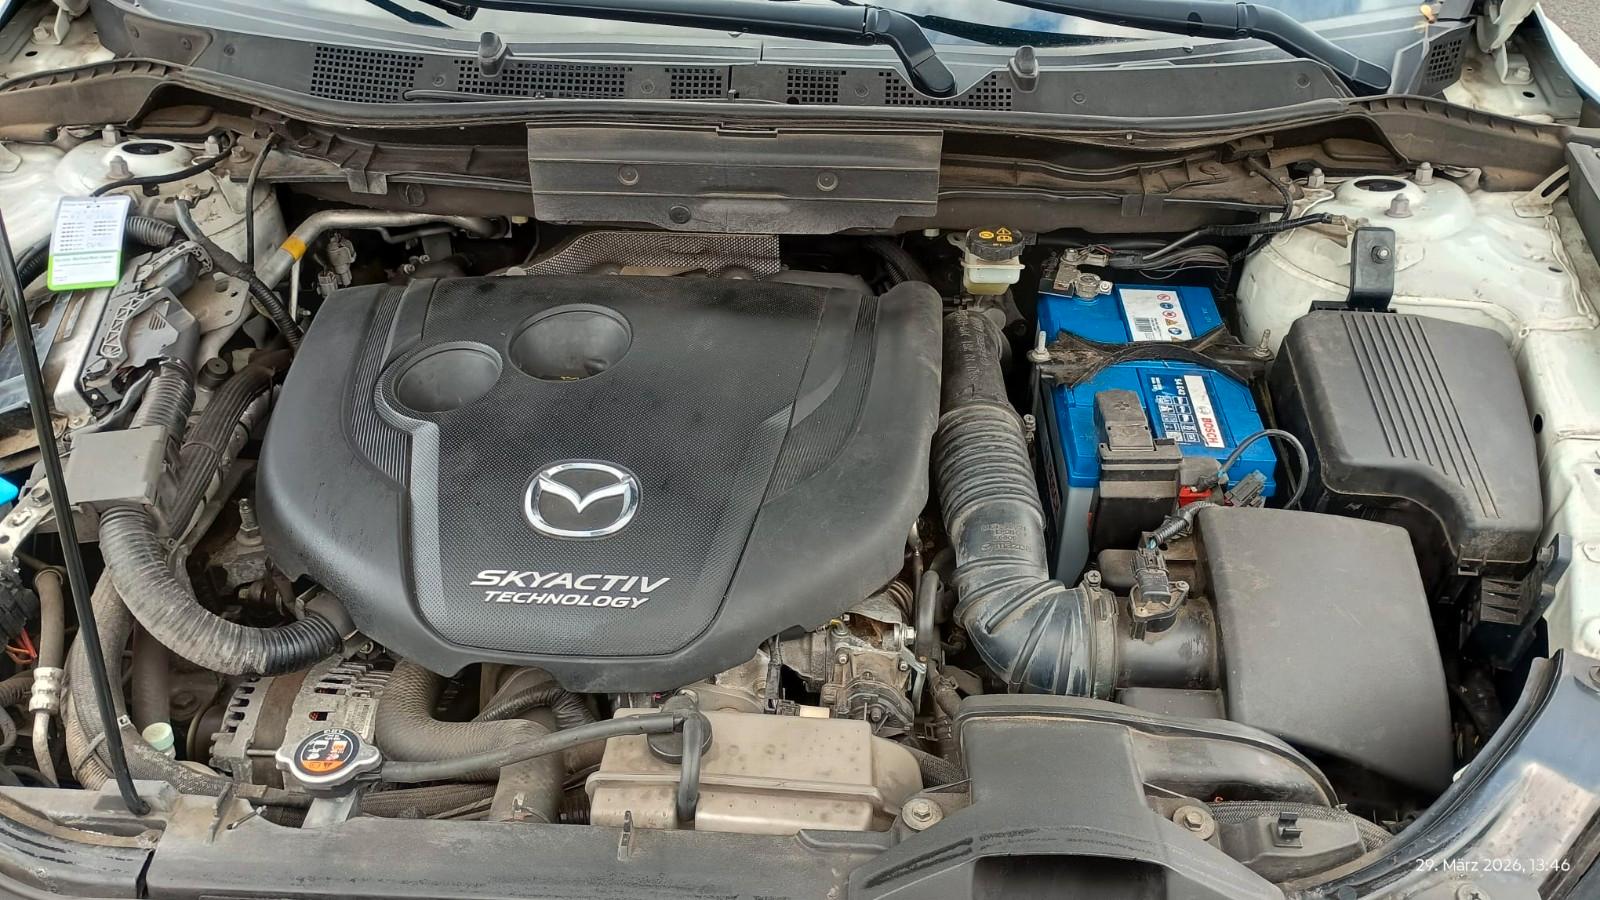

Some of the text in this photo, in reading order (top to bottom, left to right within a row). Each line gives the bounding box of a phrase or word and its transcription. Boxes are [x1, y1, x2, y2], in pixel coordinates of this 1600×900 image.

[1201, 417, 1218, 444] BOSCH
[470, 570, 670, 593] SKYACTIV
[485, 591, 648, 609] TECHNOLOGY
